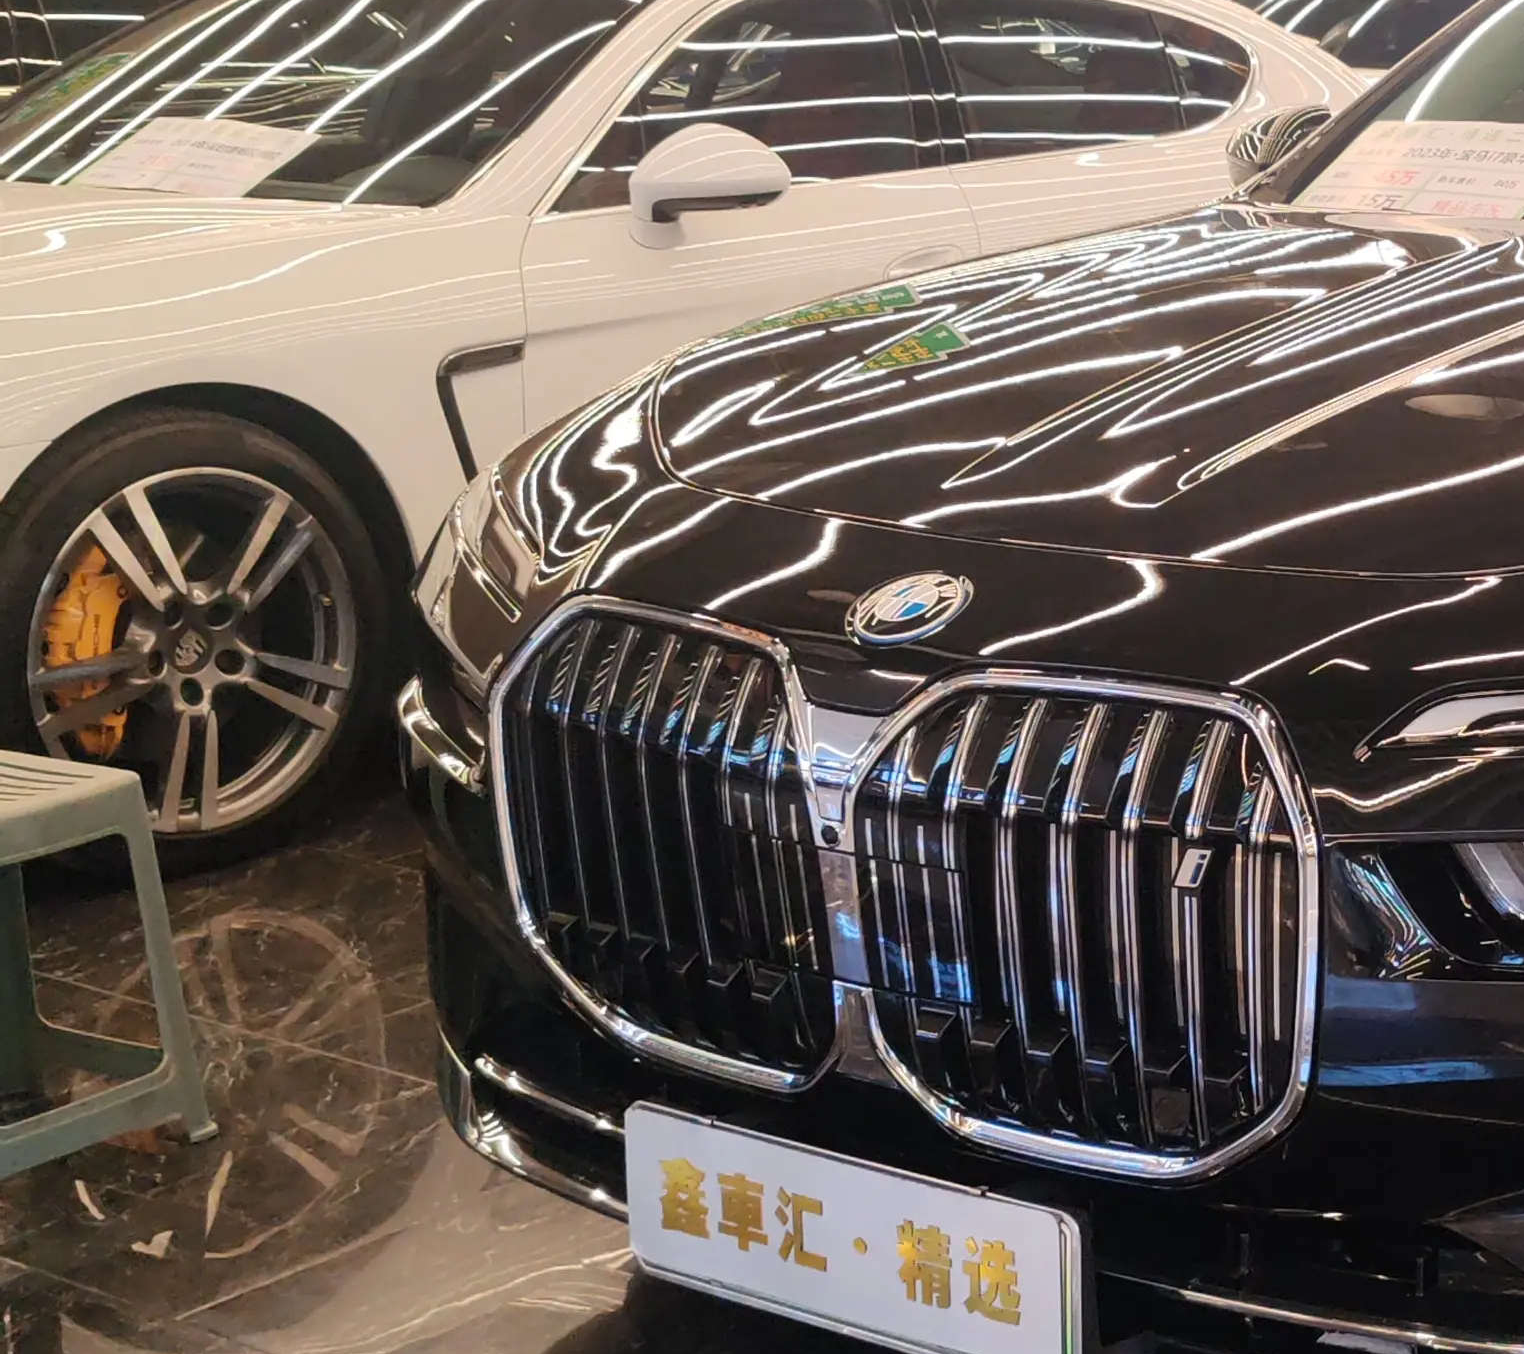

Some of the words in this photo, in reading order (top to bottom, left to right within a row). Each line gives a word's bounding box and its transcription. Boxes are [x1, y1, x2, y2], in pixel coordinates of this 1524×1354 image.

[658, 1156, 1022, 1326] 鑫車汇·精选
